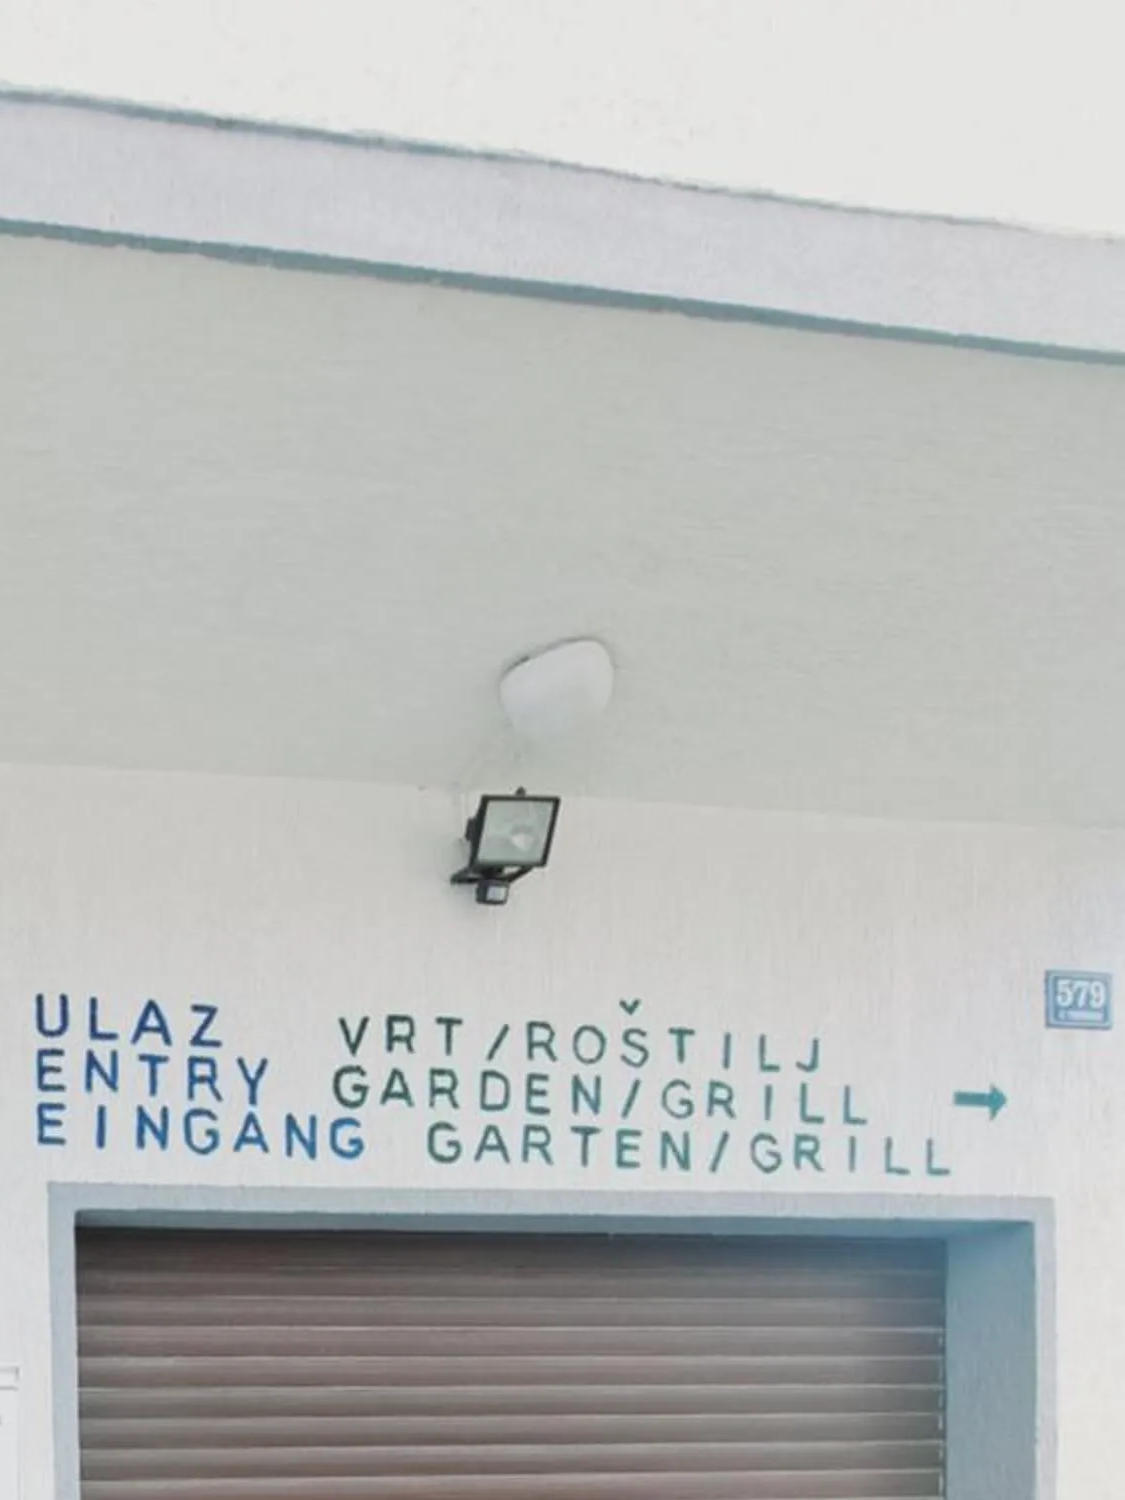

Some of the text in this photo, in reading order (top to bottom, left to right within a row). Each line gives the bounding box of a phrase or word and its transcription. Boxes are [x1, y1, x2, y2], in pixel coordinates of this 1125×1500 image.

[35, 992, 223, 1049] ULAZ
[1056, 979, 1106, 1008] 579
[338, 999, 820, 1075] VRT/ROŠTILJ
[36, 1047, 269, 1107] ENTRY
[332, 1064, 868, 1125] GARDEN/GRILL
[36, 1101, 366, 1161] EINGANG
[427, 1121, 952, 1176] GARTEN/GRILL
